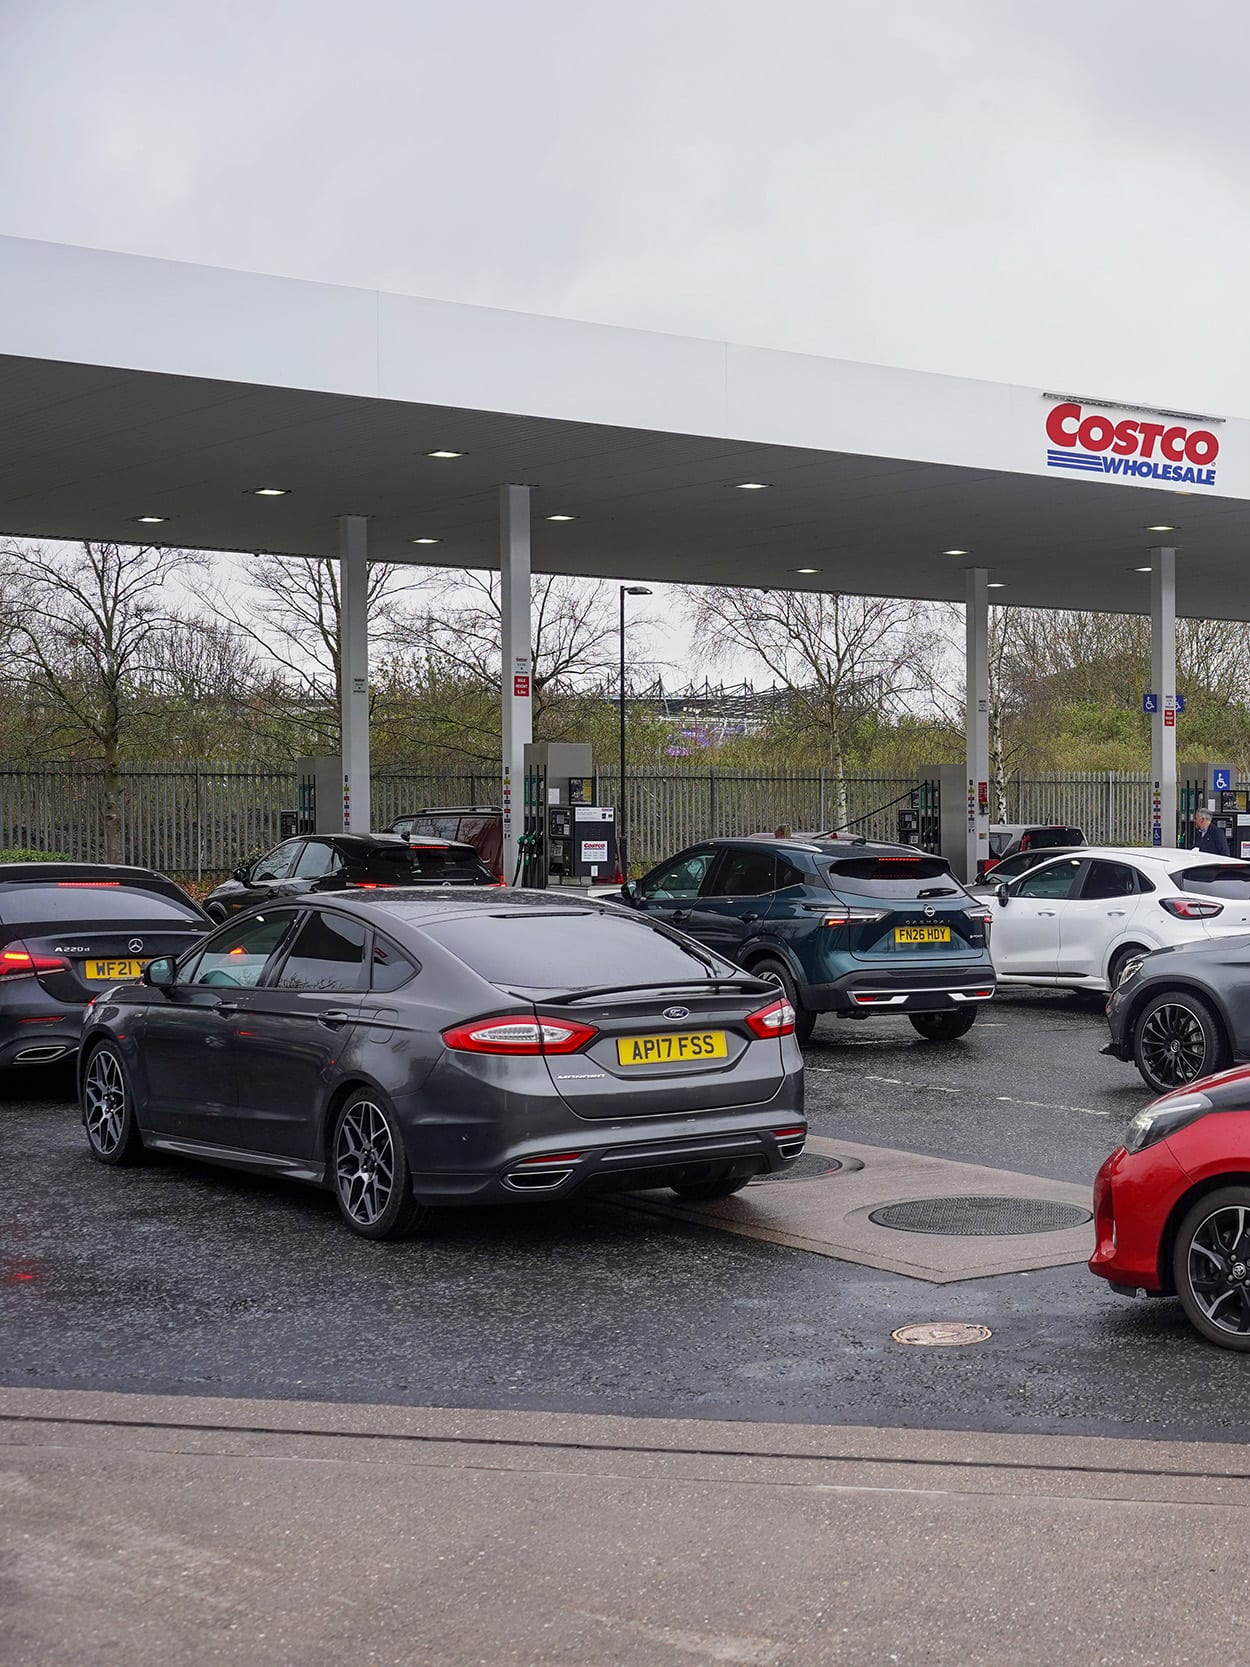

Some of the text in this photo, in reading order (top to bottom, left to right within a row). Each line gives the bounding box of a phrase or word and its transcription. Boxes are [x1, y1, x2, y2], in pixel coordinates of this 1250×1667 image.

[1046, 403, 1219, 465] COSTCO
[1101, 456, 1216, 485] WHOLESALE
[900, 928, 946, 940] FN26 HDY
[96, 961, 132, 976] WF21
[632, 1035, 715, 1060] AP17 FSS
